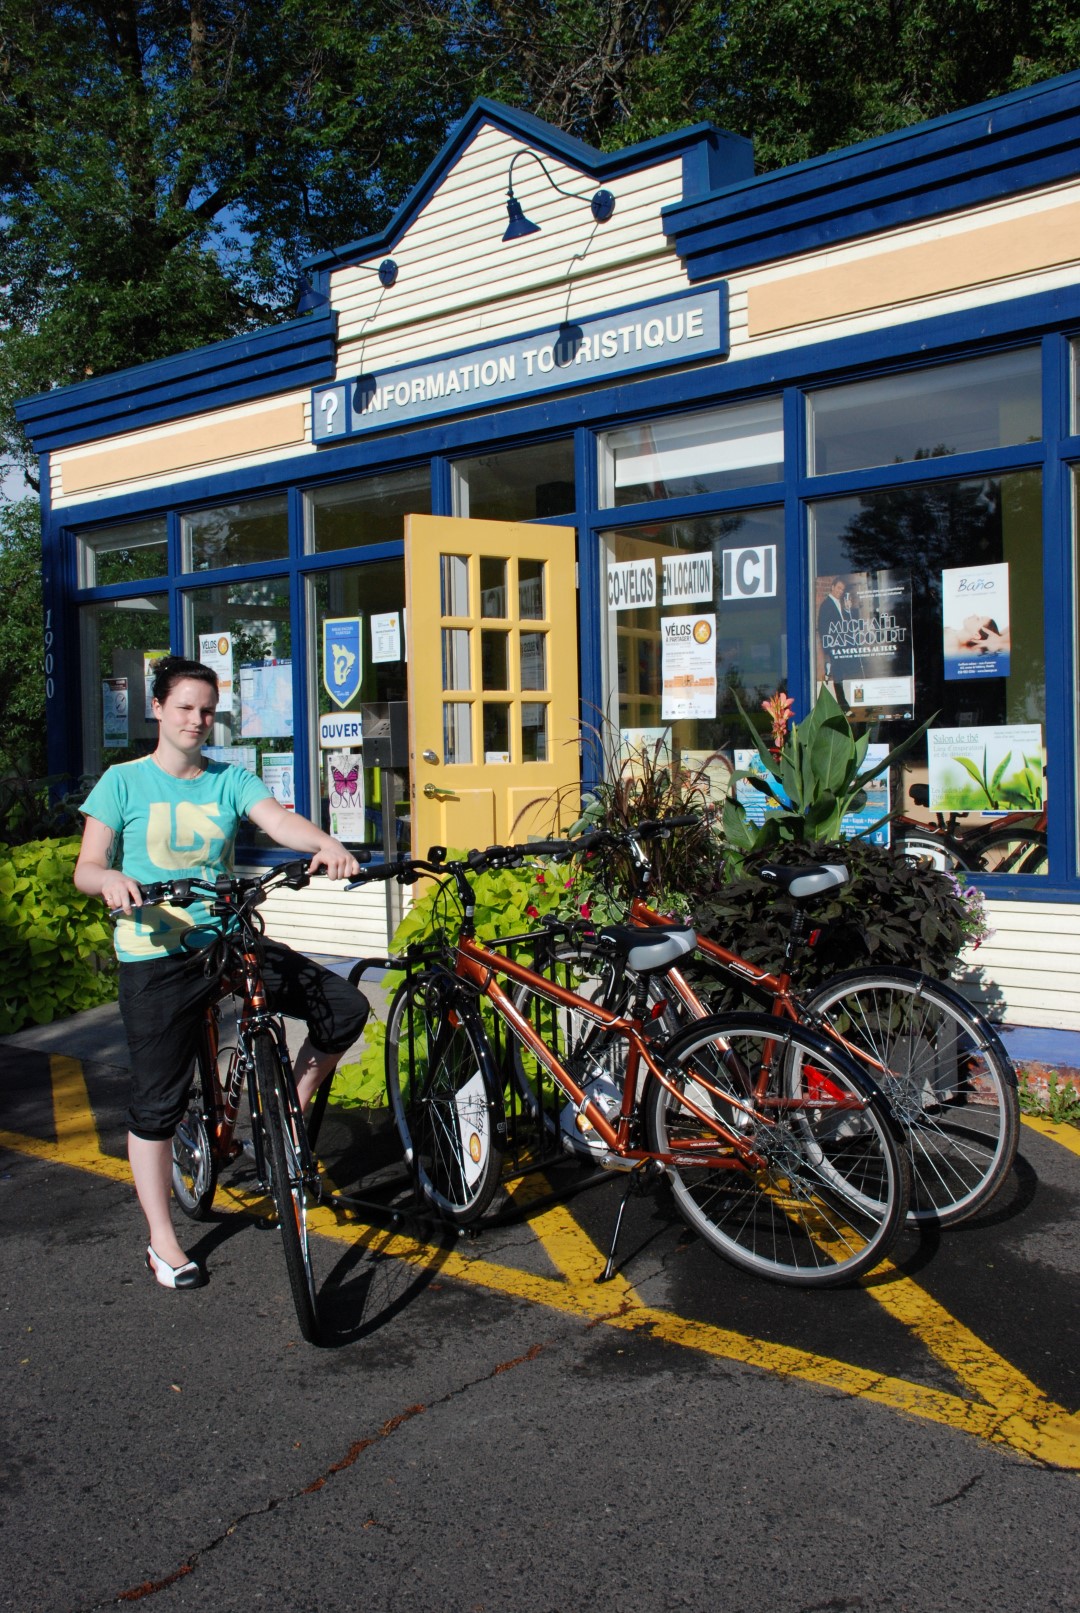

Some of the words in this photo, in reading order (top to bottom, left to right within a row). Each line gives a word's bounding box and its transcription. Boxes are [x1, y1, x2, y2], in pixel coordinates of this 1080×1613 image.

[362, 355, 516, 415] INFORMATION
[523, 308, 704, 378] TOURISTIQUE
[662, 564, 672, 597] EN
[674, 559, 711, 596] LOCATION
[723, 548, 773, 597] ICI
[958, 578, 995, 592] Baño
[665, 622, 691, 636] VÉLOS
[933, 734, 954, 743] Salon
[956, 733, 965, 743] de
[967, 732, 979, 743] thé
[331, 790, 361, 808] OSM
